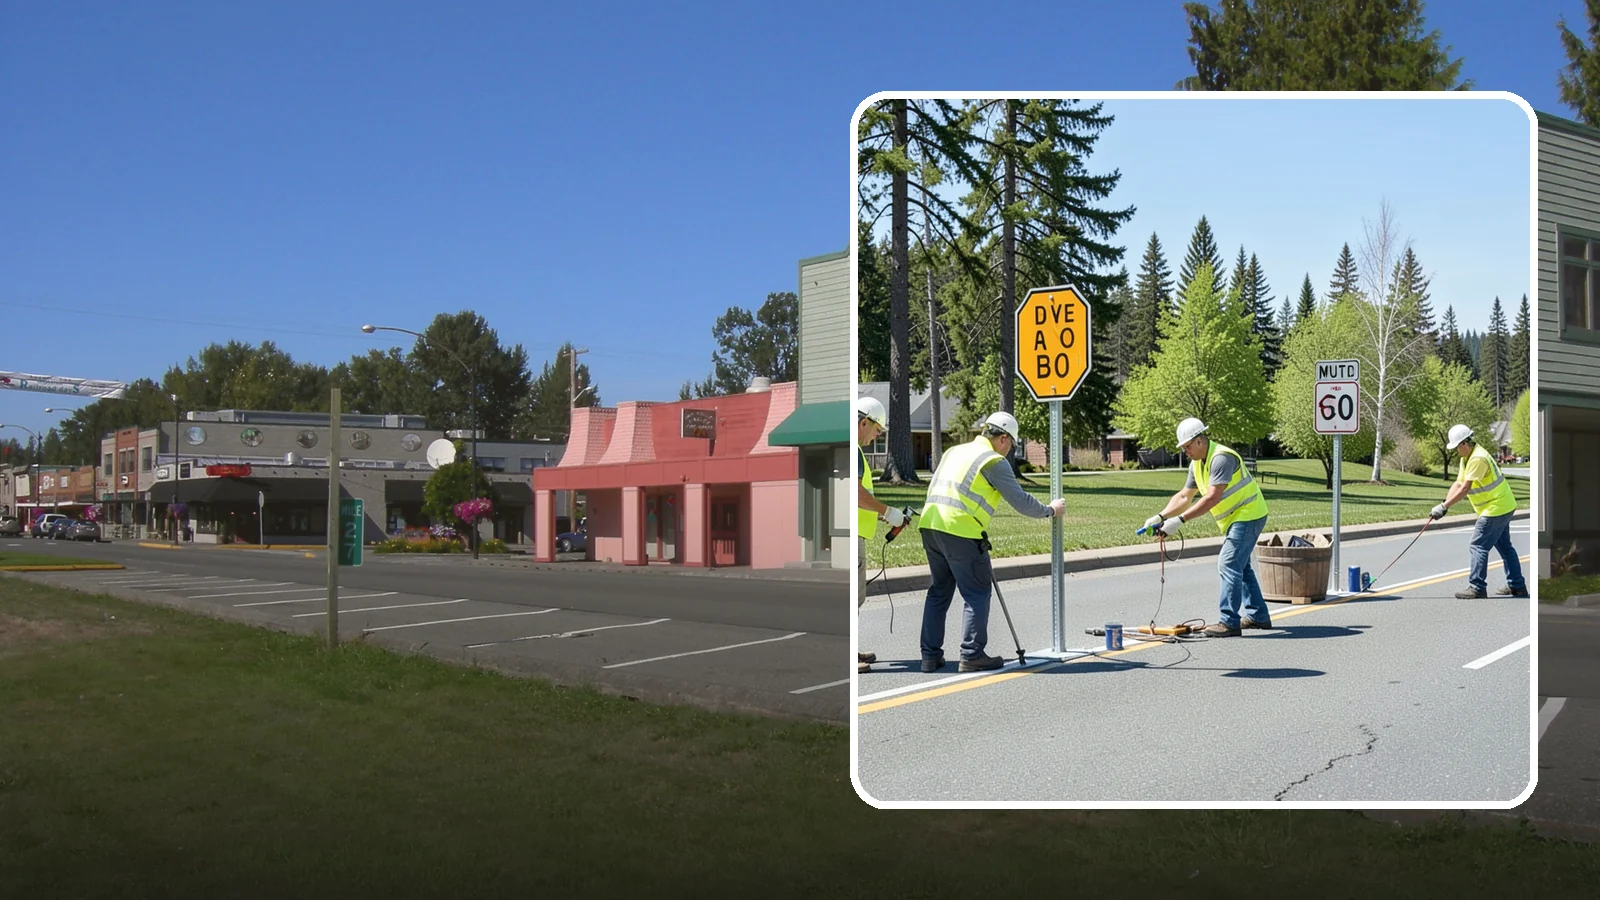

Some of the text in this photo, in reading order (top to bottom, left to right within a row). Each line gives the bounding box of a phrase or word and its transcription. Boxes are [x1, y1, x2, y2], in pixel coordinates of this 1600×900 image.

[1037, 352, 1070, 379] BO
[20, 379, 56, 392] Railroad
[1318, 393, 1354, 421] 60
[341, 505, 362, 517] MILE
